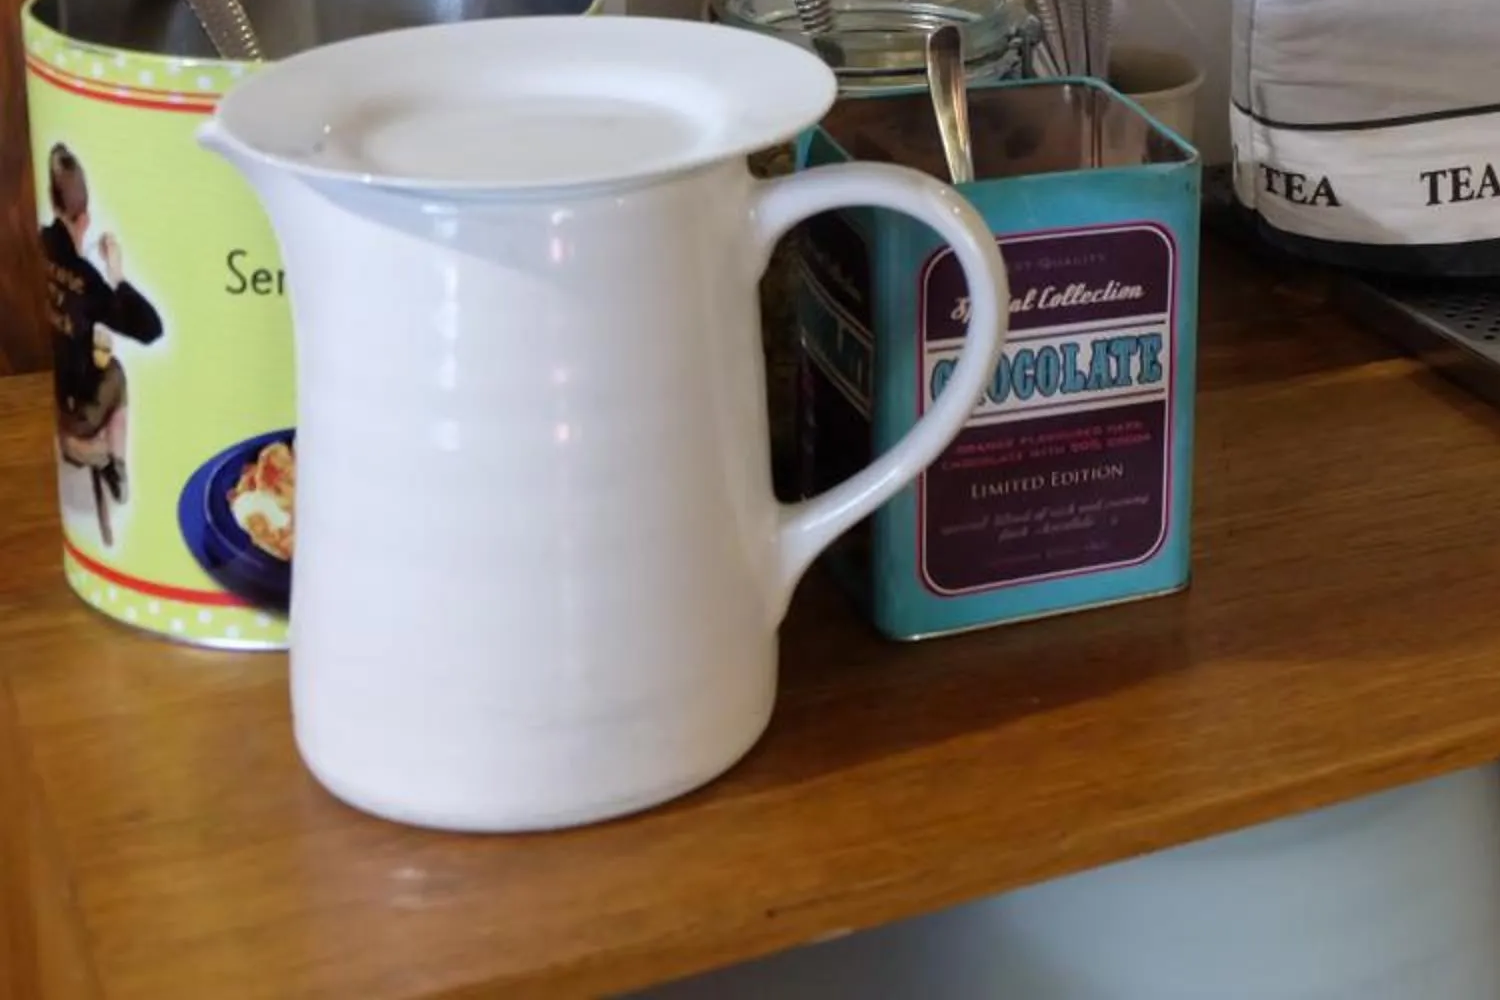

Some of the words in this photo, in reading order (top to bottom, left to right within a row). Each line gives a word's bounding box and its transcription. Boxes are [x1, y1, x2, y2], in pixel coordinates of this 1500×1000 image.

[1258, 162, 1343, 207] TEA
[1037, 279, 1145, 310] Collection
[931, 331, 1163, 406] COCOLATE
[970, 474, 1045, 499] LIMITED
[1050, 463, 1124, 488] EDITION
